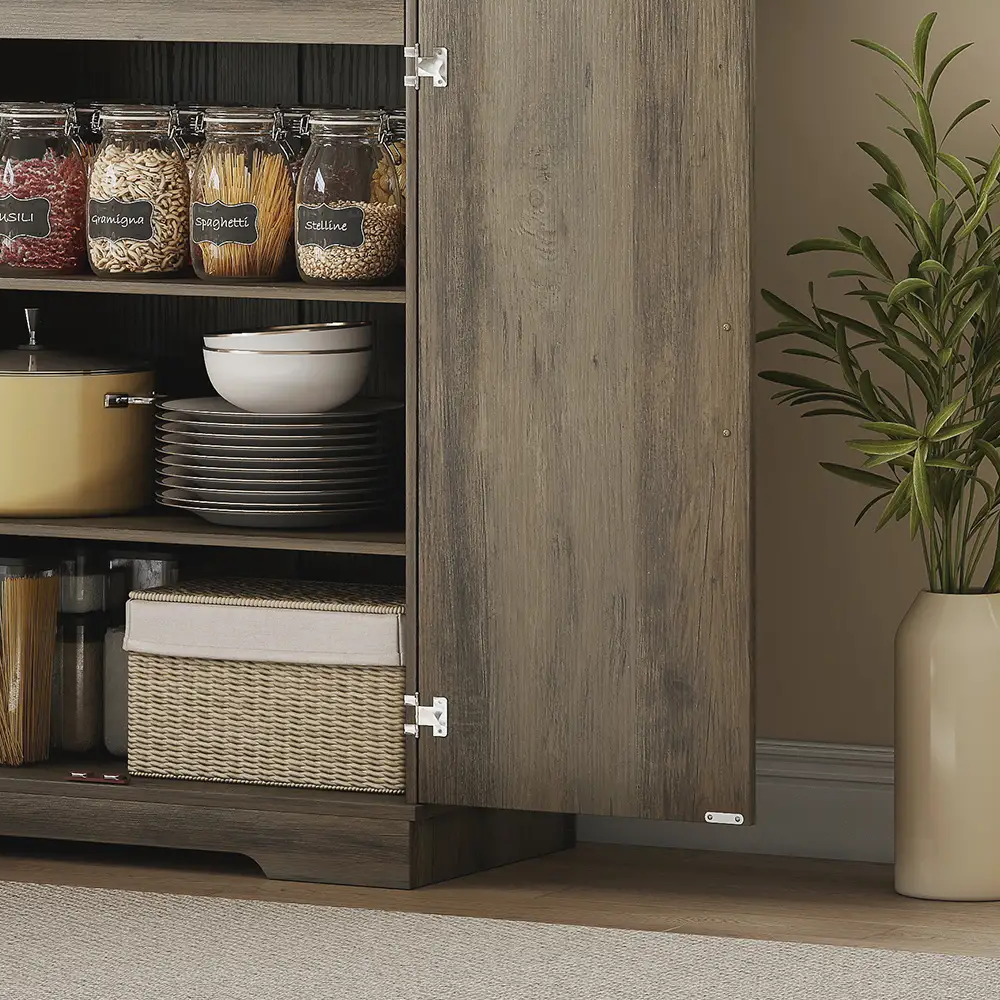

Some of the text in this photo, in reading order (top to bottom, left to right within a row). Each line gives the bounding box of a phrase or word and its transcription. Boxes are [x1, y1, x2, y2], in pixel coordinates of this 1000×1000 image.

[91, 214, 144, 232] Gramigna
[194, 215, 251, 231] Spaghetti
[304, 219, 348, 232] Stelline
